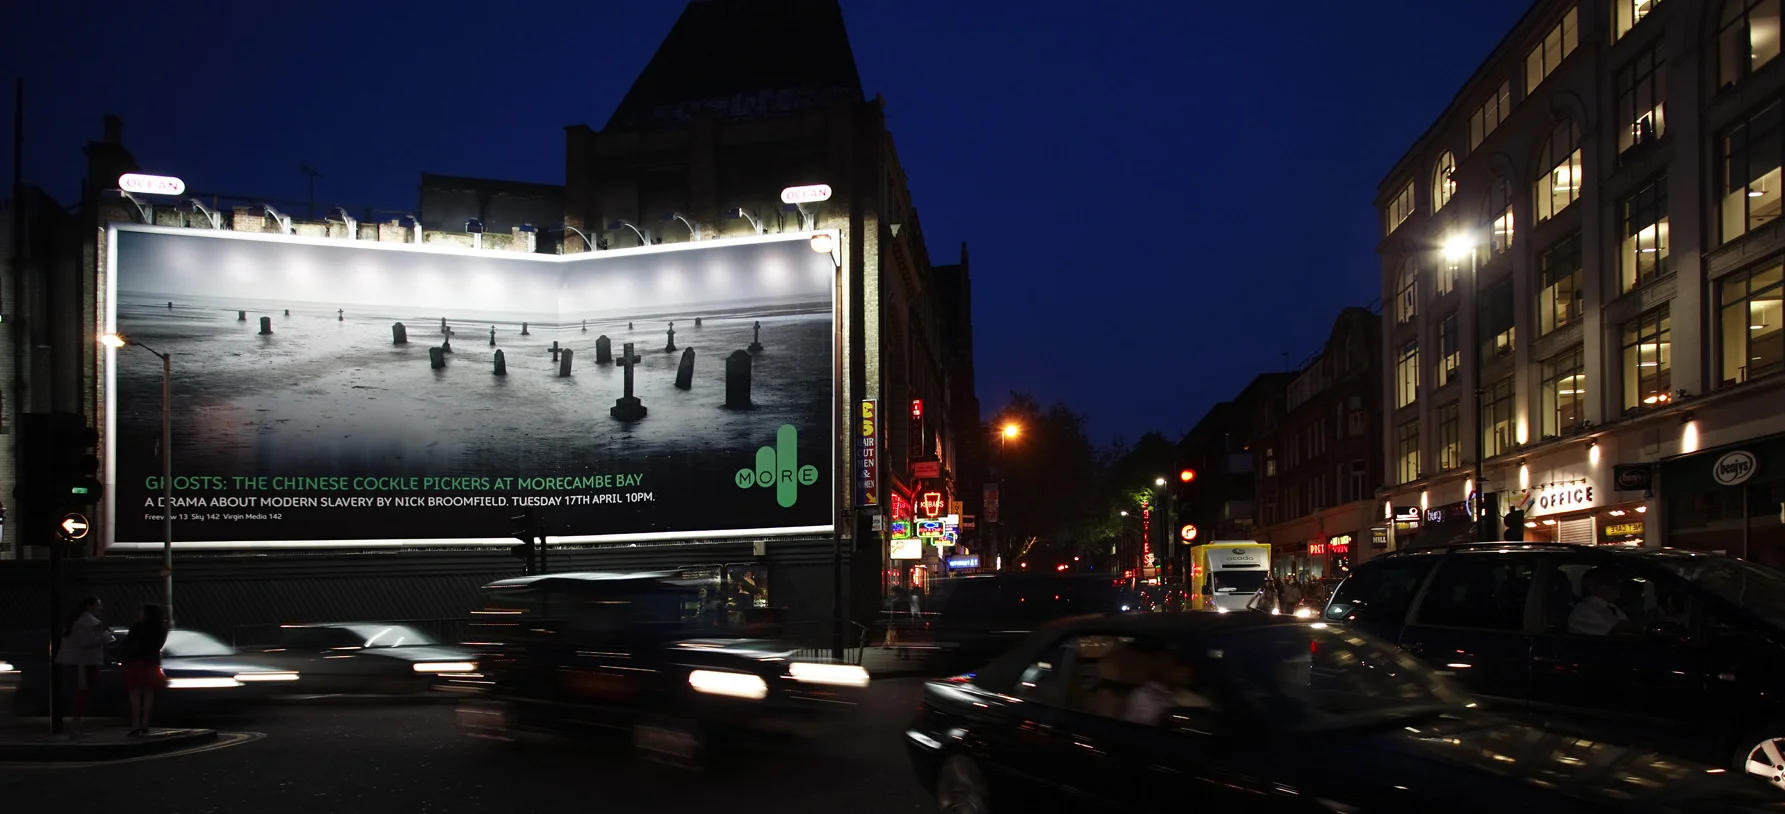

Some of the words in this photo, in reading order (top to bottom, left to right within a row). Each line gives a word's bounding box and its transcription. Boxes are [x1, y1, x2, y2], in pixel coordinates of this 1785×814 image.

[739, 468, 813, 485] MORE
[1720, 460, 1749, 477] benjys
[145, 476, 227, 490] GHOSTS:
[232, 476, 268, 490] THE
[272, 476, 349, 490] CHINESE
[353, 477, 419, 491] COCKLE
[423, 476, 490, 491] PICKERS
[493, 477, 514, 490] AT
[518, 475, 613, 490] MORECAMBE
[616, 473, 643, 487] BAY
[144, 497, 155, 507] A
[158, 497, 208, 507] DRAMA
[209, 497, 258, 507] ABOUT
[260, 497, 318, 507] MODERN
[320, 496, 374, 507] SLAVERY
[376, 496, 393, 507] BY
[395, 496, 425, 507] NICK
[427, 496, 509, 507] BROOMFIELD.
[511, 496, 562, 506] TUESDAY
[564, 495, 590, 505] 17TH
[592, 493, 622, 504] APRIL
[625, 492, 656, 503] 10PM.
[1540, 487, 1593, 509] OFFICE
[191, 513, 205, 522] Sky
[222, 513, 245, 522] Virgin
